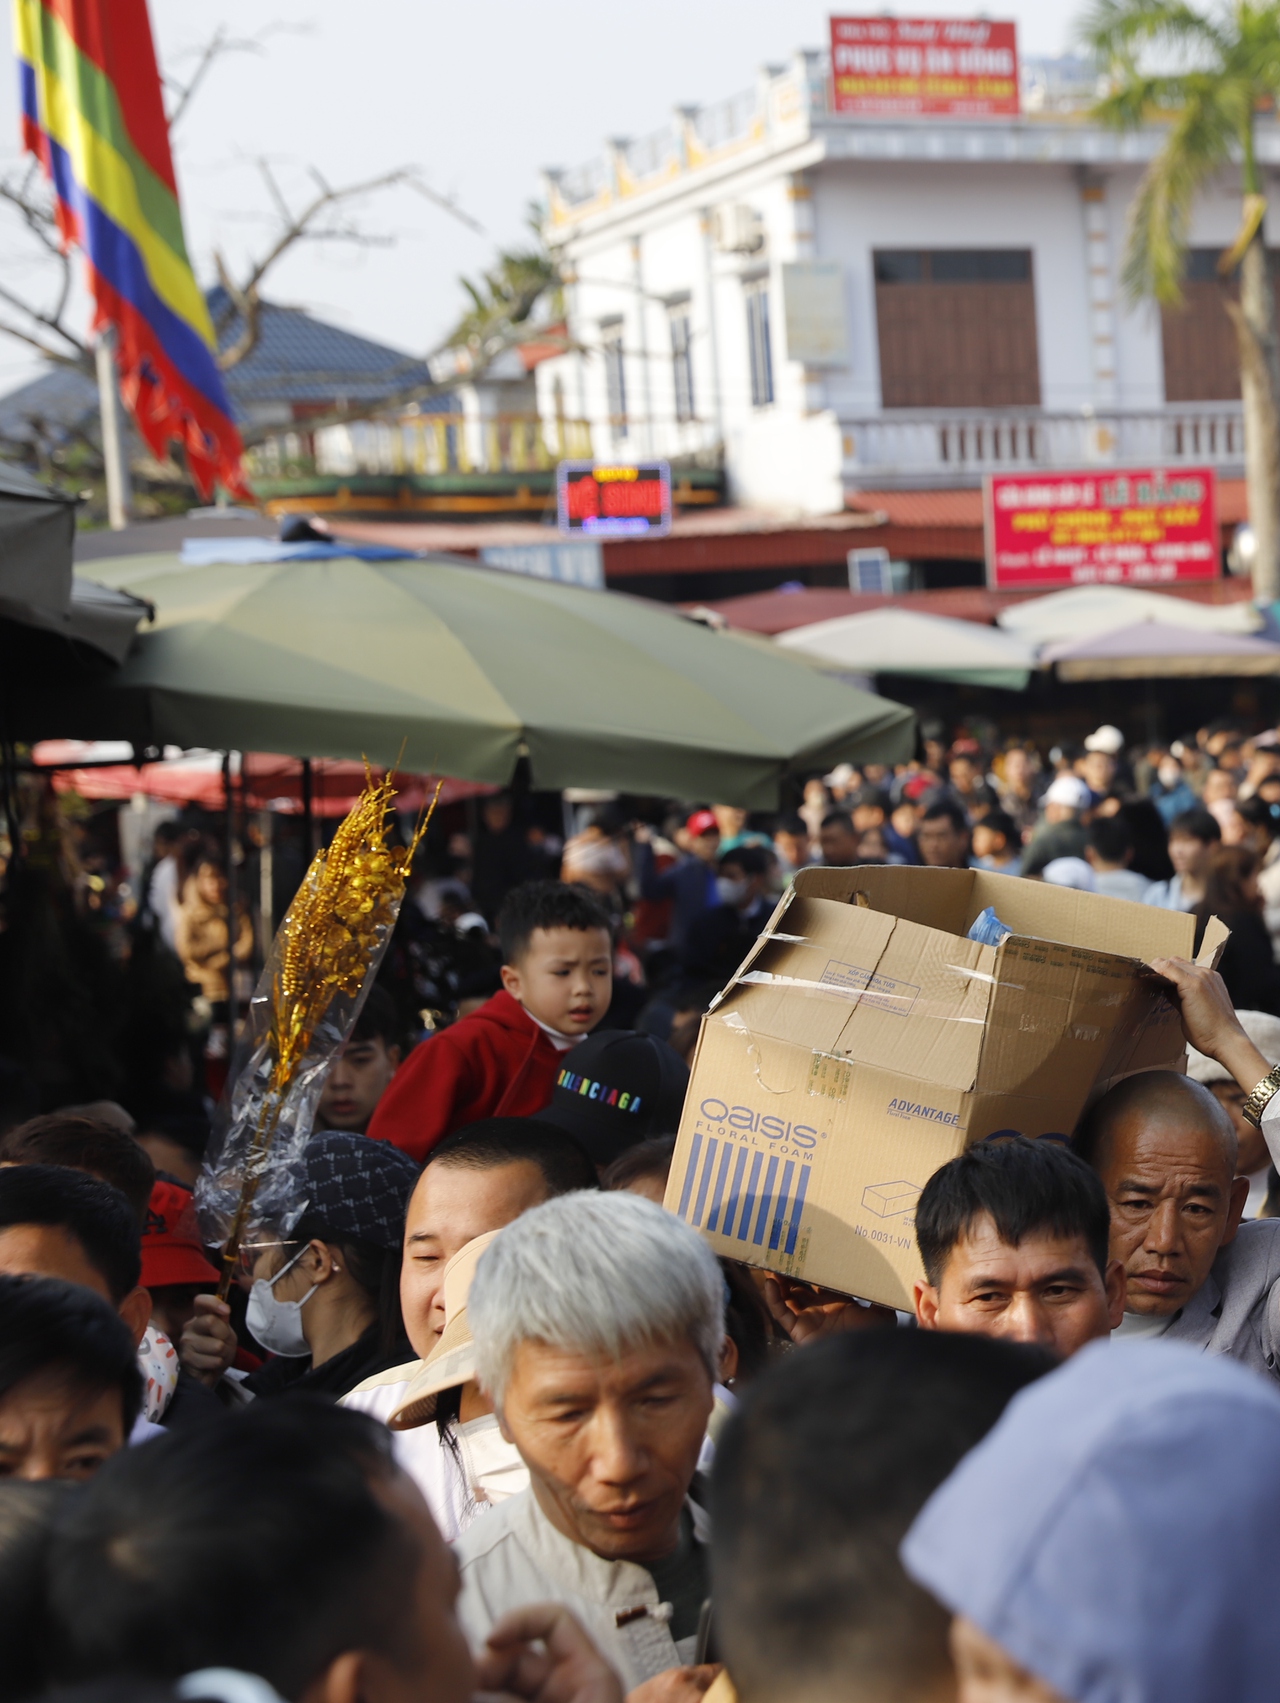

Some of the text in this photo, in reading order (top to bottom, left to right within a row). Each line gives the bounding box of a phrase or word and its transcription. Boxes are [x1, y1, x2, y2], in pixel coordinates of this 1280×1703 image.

[557, 1068, 642, 1114] BALENCIAGA
[888, 1098, 960, 1126] ADVANTAGE
[696, 1120, 814, 1161] FLORAL FOAM
[855, 1225, 911, 1249] No.0031-VN
